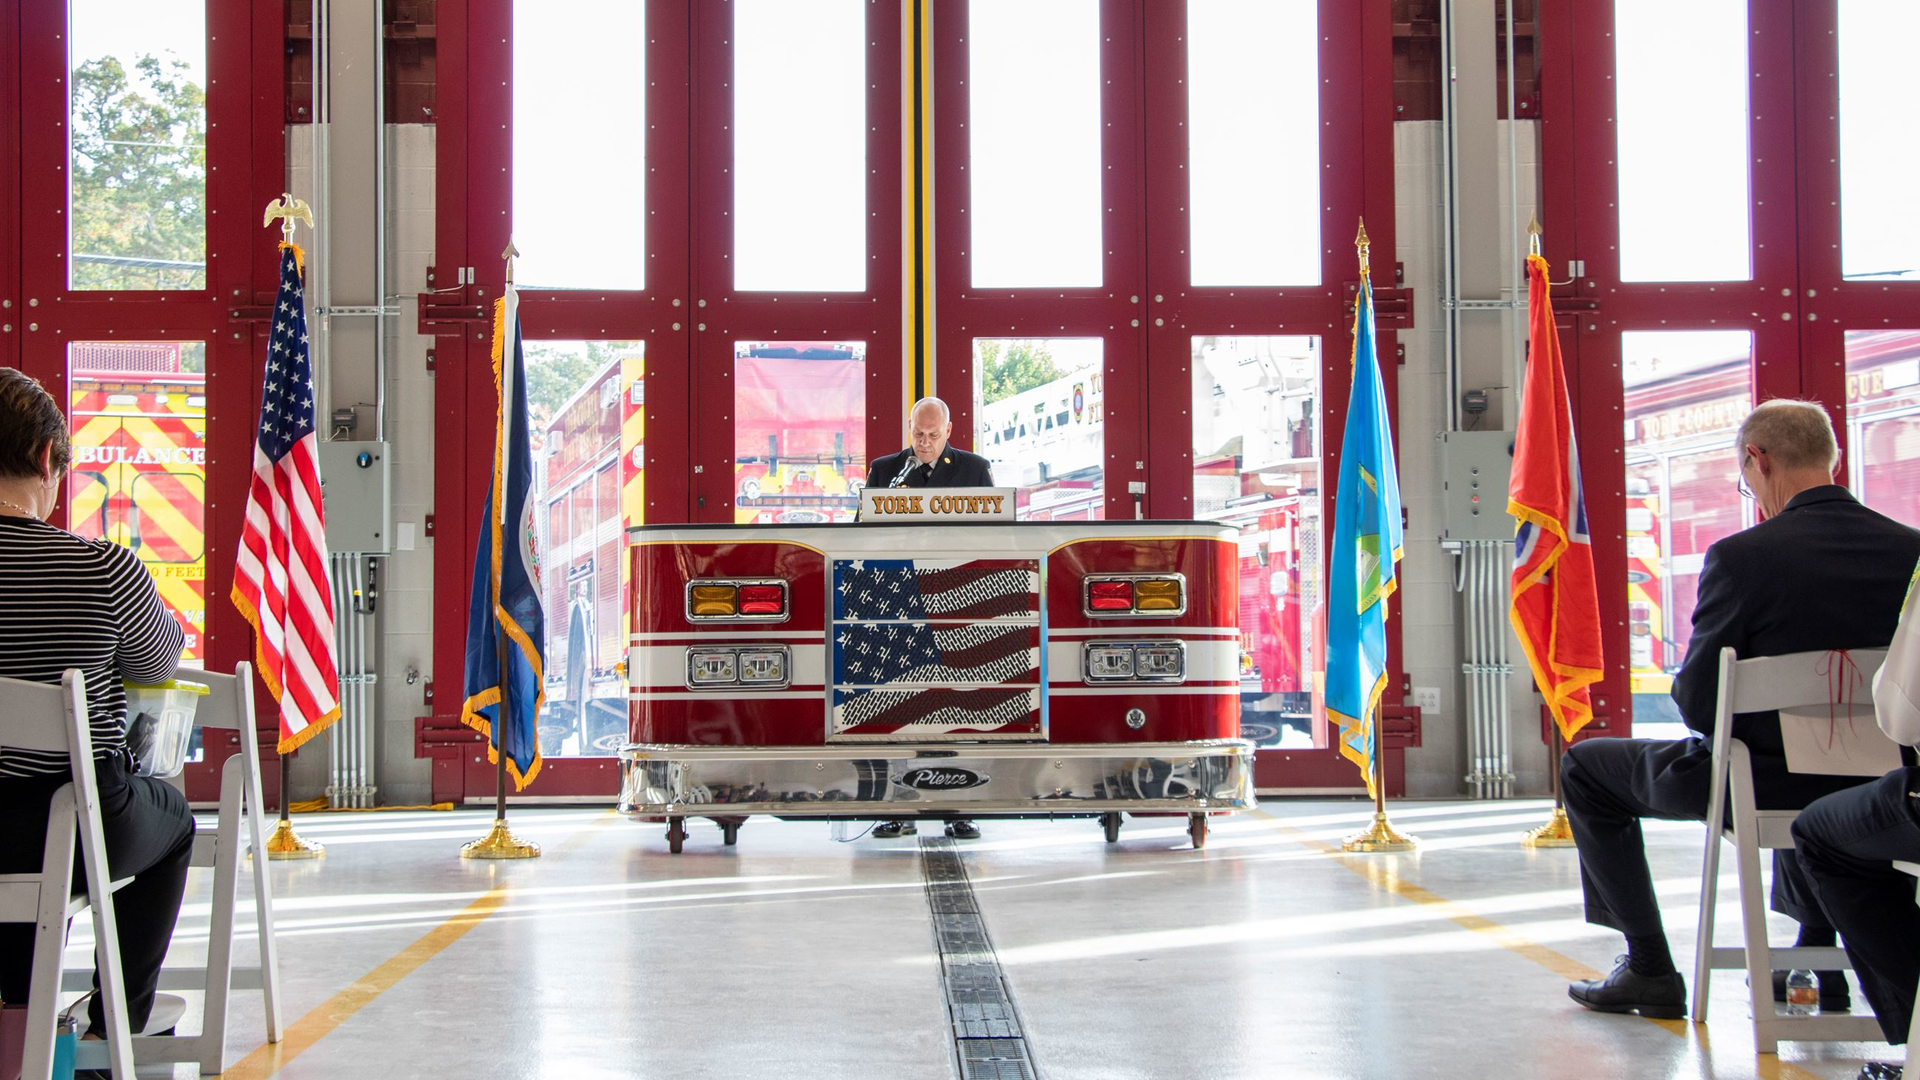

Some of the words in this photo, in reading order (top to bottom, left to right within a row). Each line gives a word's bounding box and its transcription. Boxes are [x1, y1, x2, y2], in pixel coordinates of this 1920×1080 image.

[71, 445, 206, 465] BULANCE
[872, 496, 923, 514] YORK
[929, 496, 1004, 514] COUNTY
[165, 567, 206, 577] FEET
[912, 769, 968, 788] Pierce
